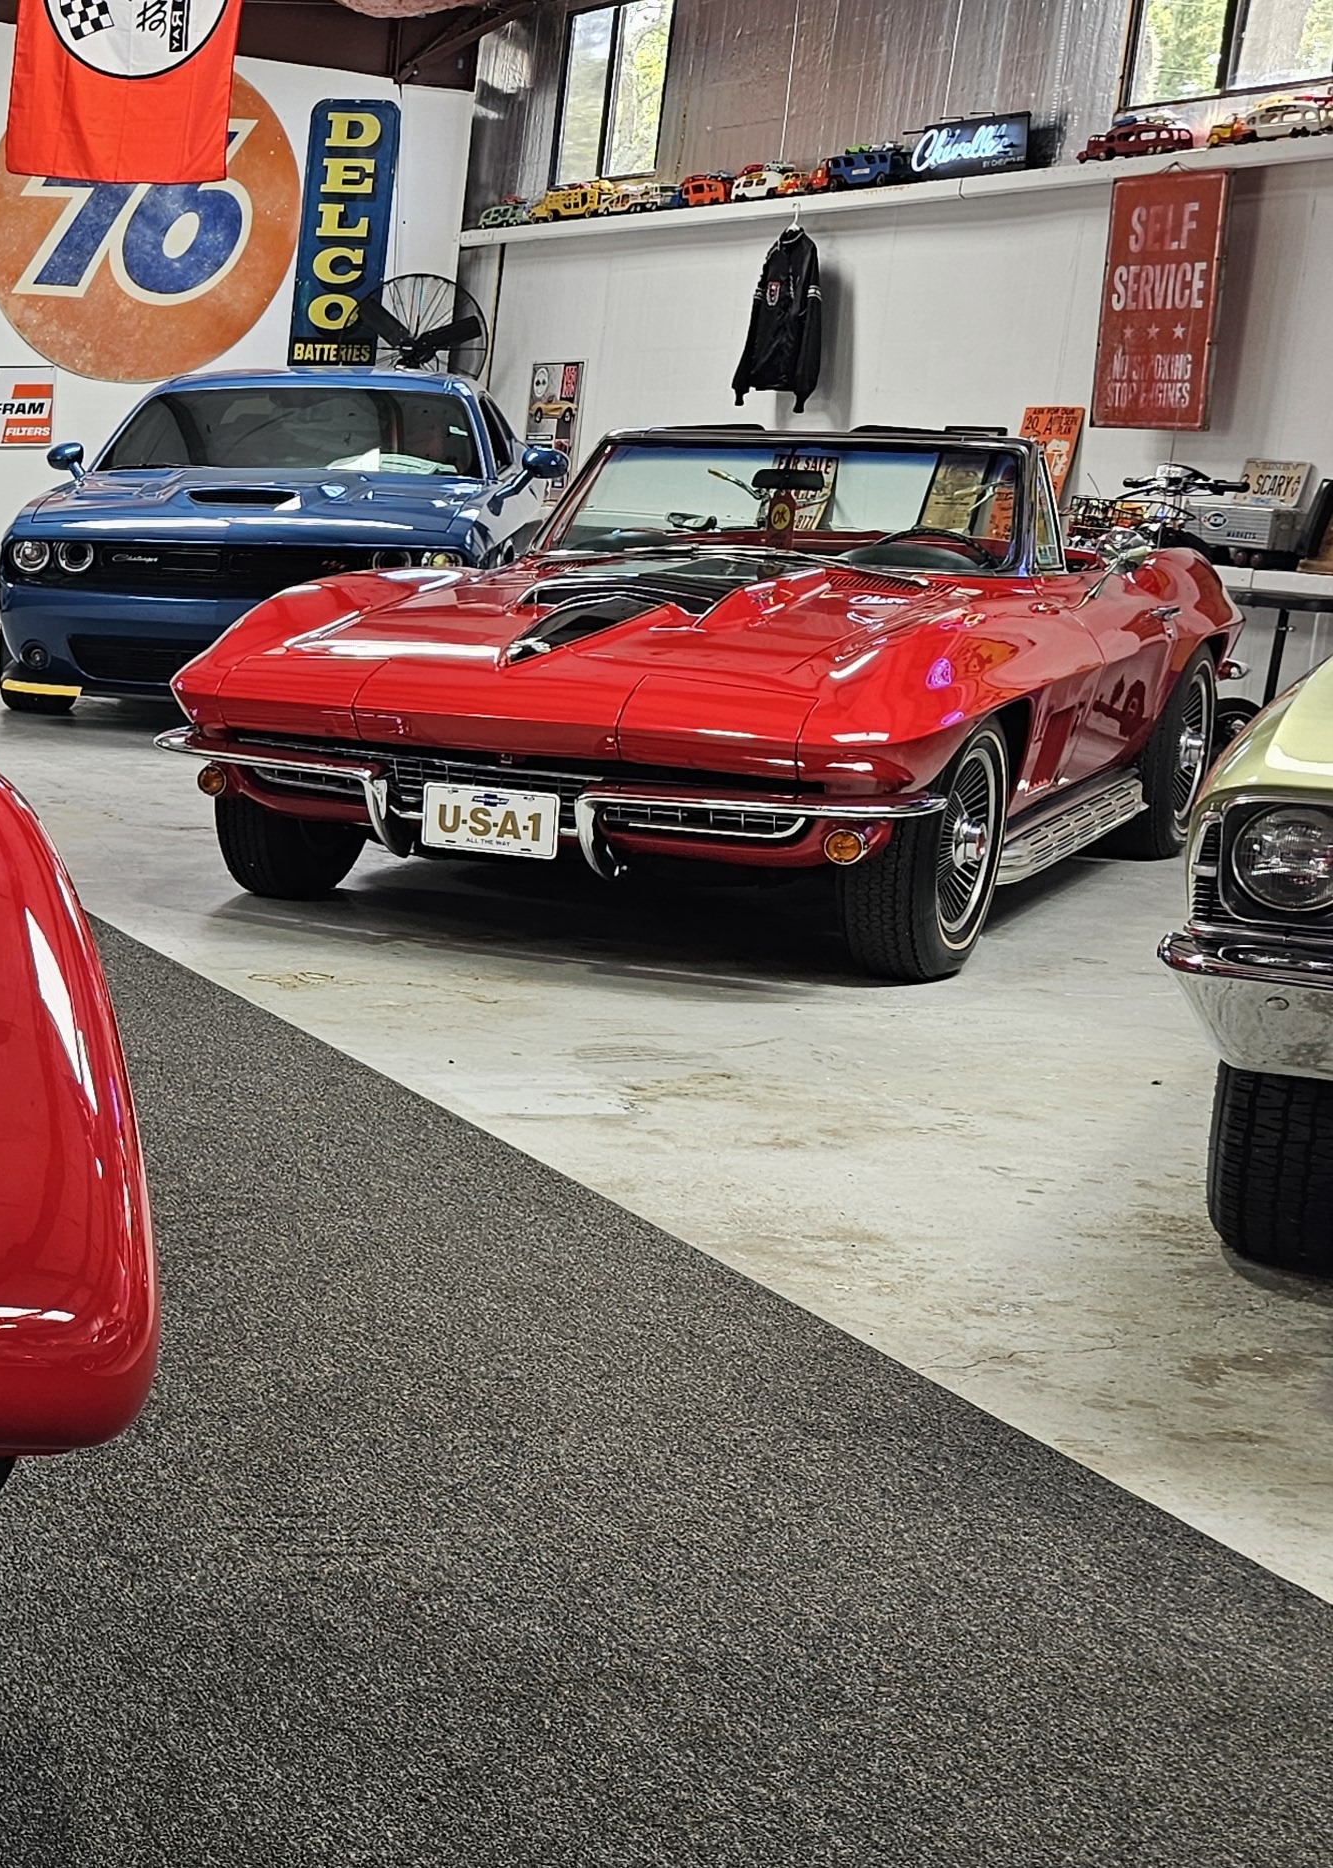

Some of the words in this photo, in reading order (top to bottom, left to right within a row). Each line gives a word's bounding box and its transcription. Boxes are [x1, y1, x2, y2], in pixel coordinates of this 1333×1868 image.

[307, 112, 382, 330] DELCO
[1129, 201, 1200, 253] SELF
[1111, 261, 1208, 312] SERVICE
[293, 343, 371, 362] BATTERIES
[5, 427, 51, 437] FILTERS
[1252, 474, 1294, 497] SCARY
[773, 506, 787, 525] OK
